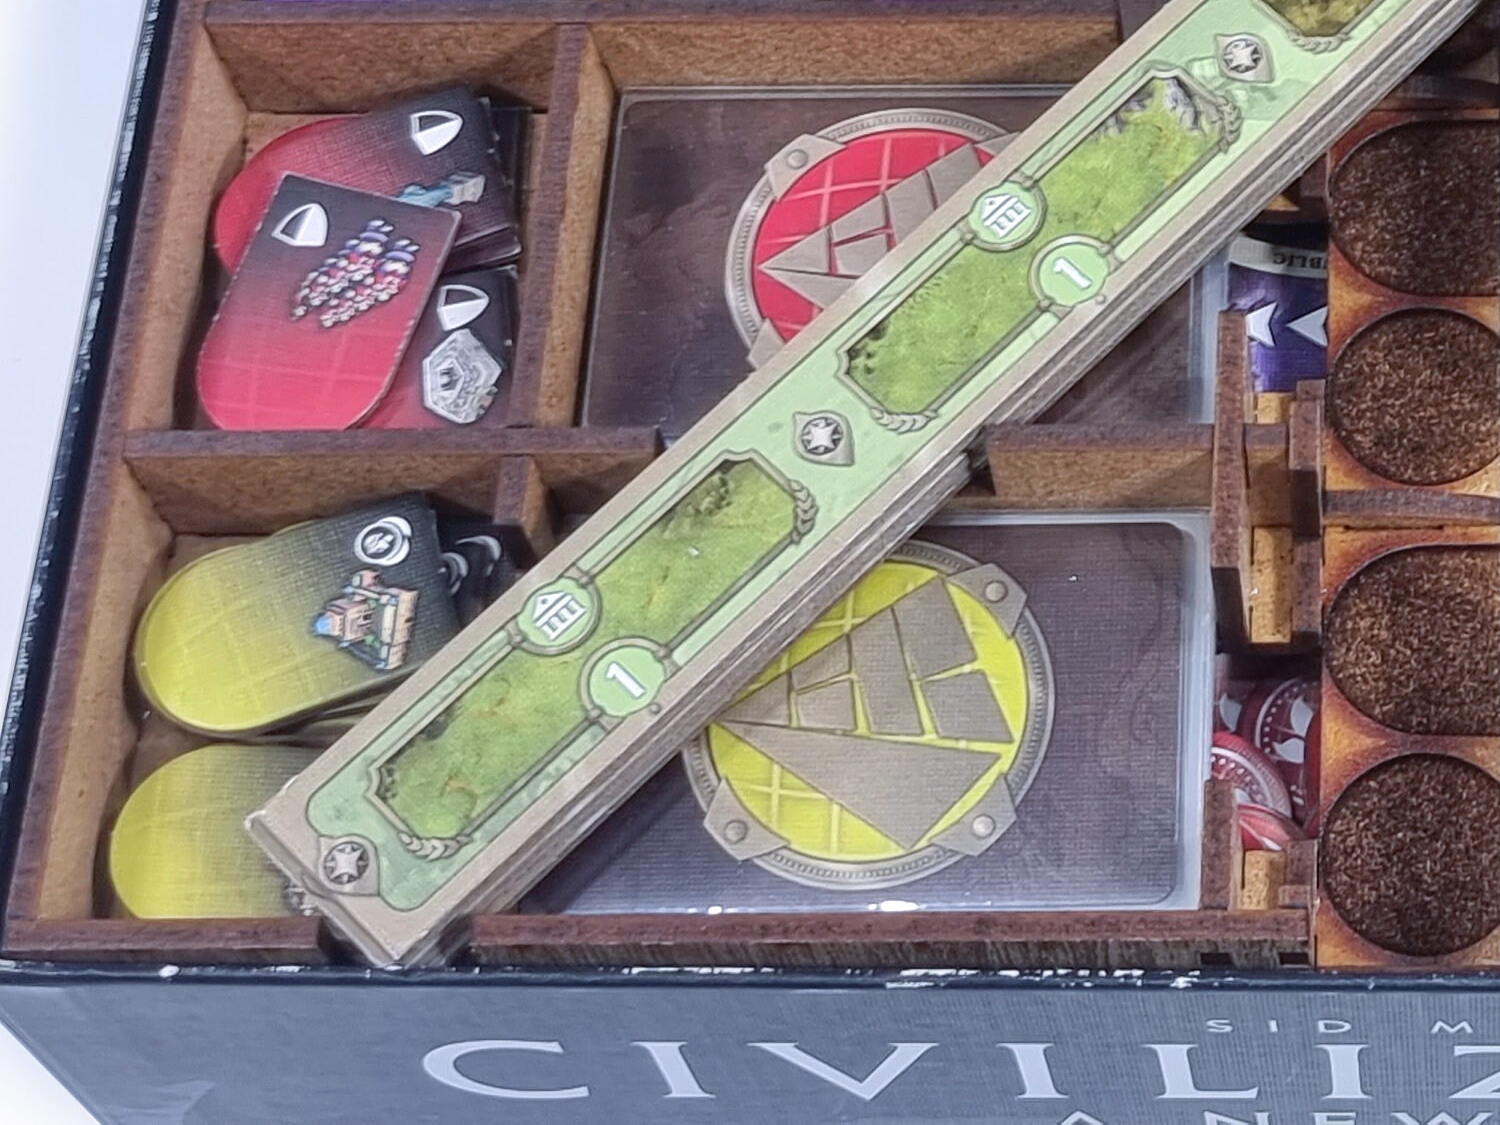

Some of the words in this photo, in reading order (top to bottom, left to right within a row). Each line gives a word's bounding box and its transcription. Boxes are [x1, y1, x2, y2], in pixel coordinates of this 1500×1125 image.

[1052, 256, 1092, 290] 1
[1273, 252, 1328, 270] BLIC
[605, 661, 646, 699] 1
[1206, 1019, 1352, 1035] SID
